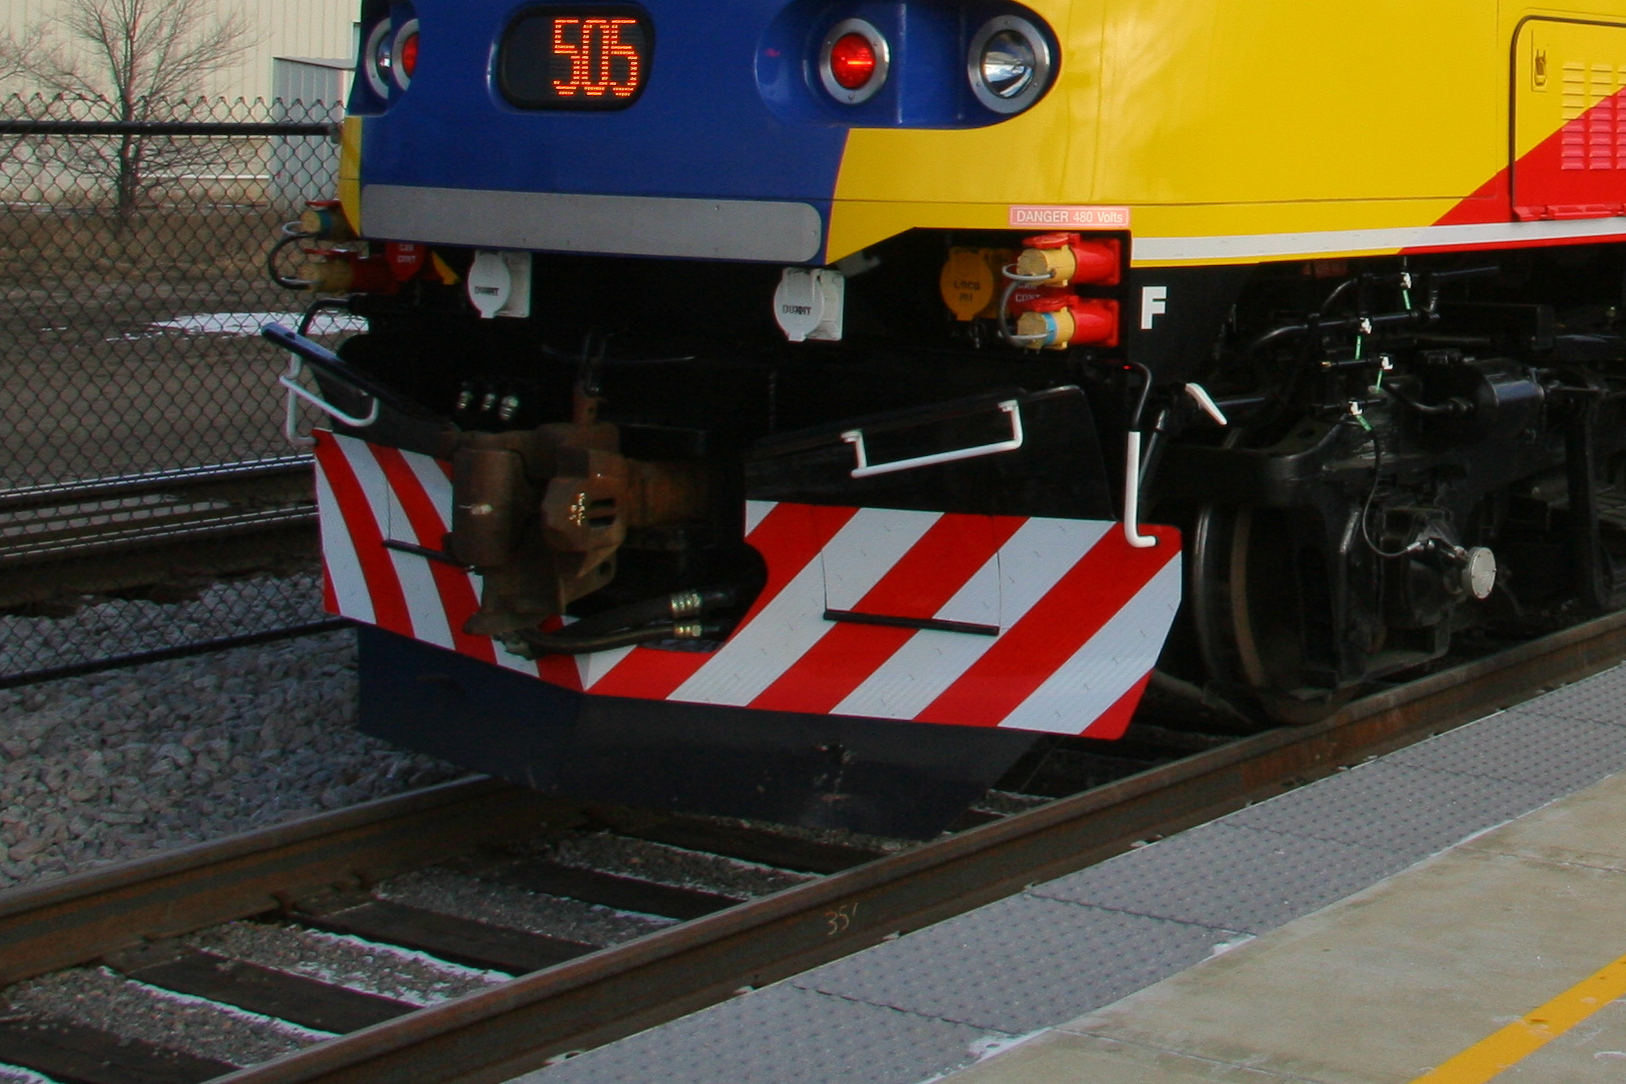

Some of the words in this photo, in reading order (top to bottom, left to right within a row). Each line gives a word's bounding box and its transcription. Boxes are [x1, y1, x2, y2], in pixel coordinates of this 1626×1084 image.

[553, 18, 639, 97] 505
[1016, 210, 1069, 223] DANGER
[1073, 210, 1093, 223] 480
[1097, 210, 1124, 224] Volts
[1141, 286, 1167, 330] F
